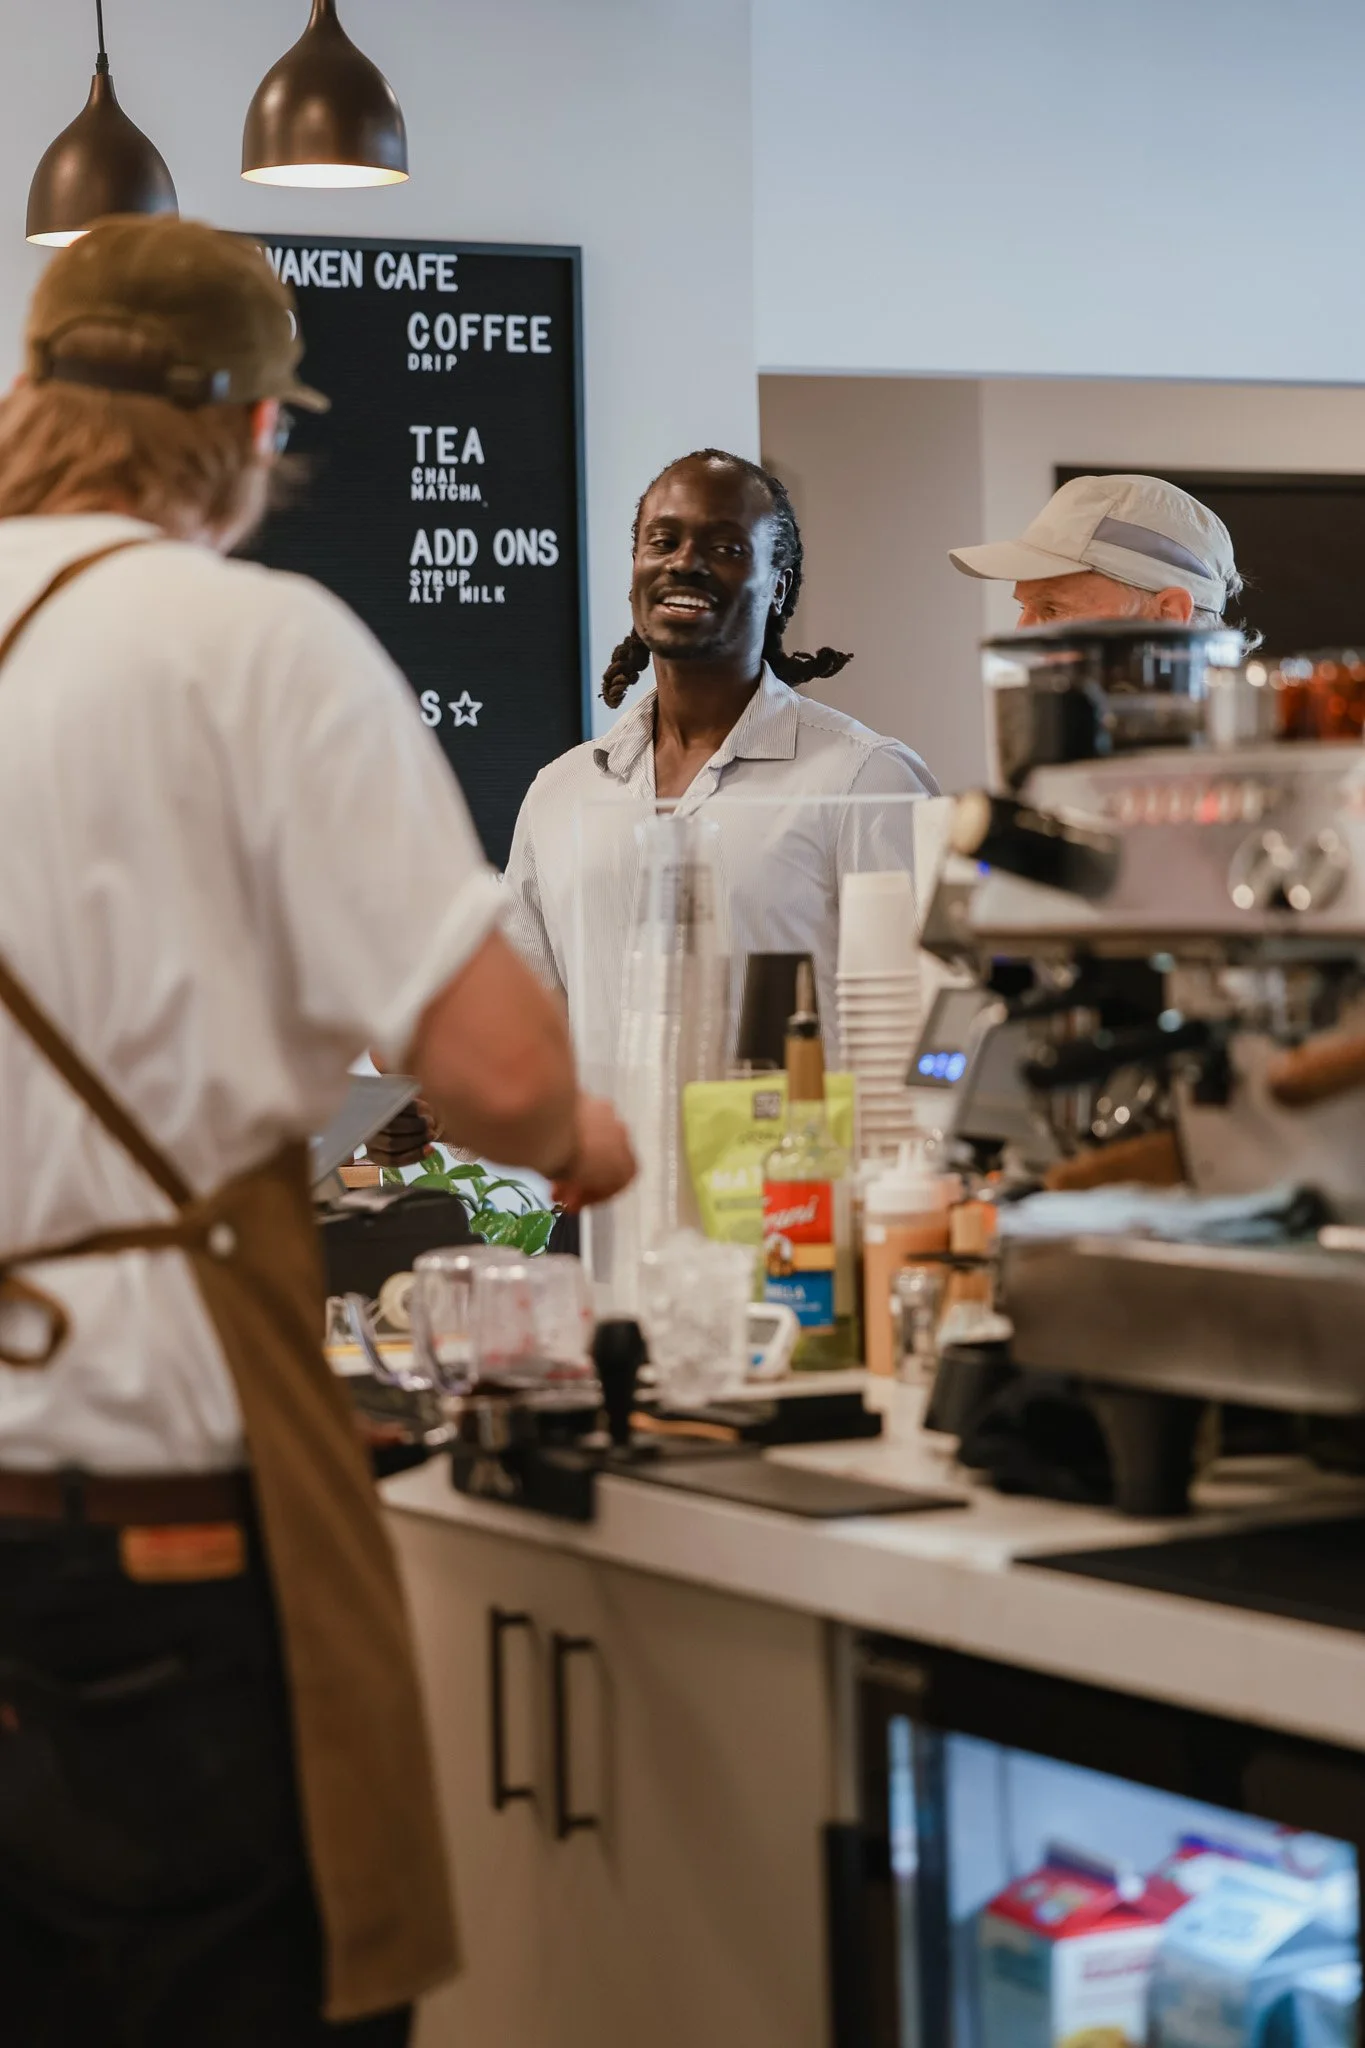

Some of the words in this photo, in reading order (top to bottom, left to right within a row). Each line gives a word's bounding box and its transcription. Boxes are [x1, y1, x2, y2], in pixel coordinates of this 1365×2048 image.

[374, 251, 459, 292] CAFE
[407, 311, 552, 353] COFFEE
[407, 353, 458, 372] DRIP
[409, 425, 485, 465] TEA
[411, 466, 456, 485] CHAI
[410, 483, 482, 501] MATCHA
[409, 528, 479, 566] ADD
[493, 528, 559, 566] ONS
[409, 569, 471, 587] SYRUP
[409, 585, 445, 603] ALT
[459, 585, 505, 603] MILK
